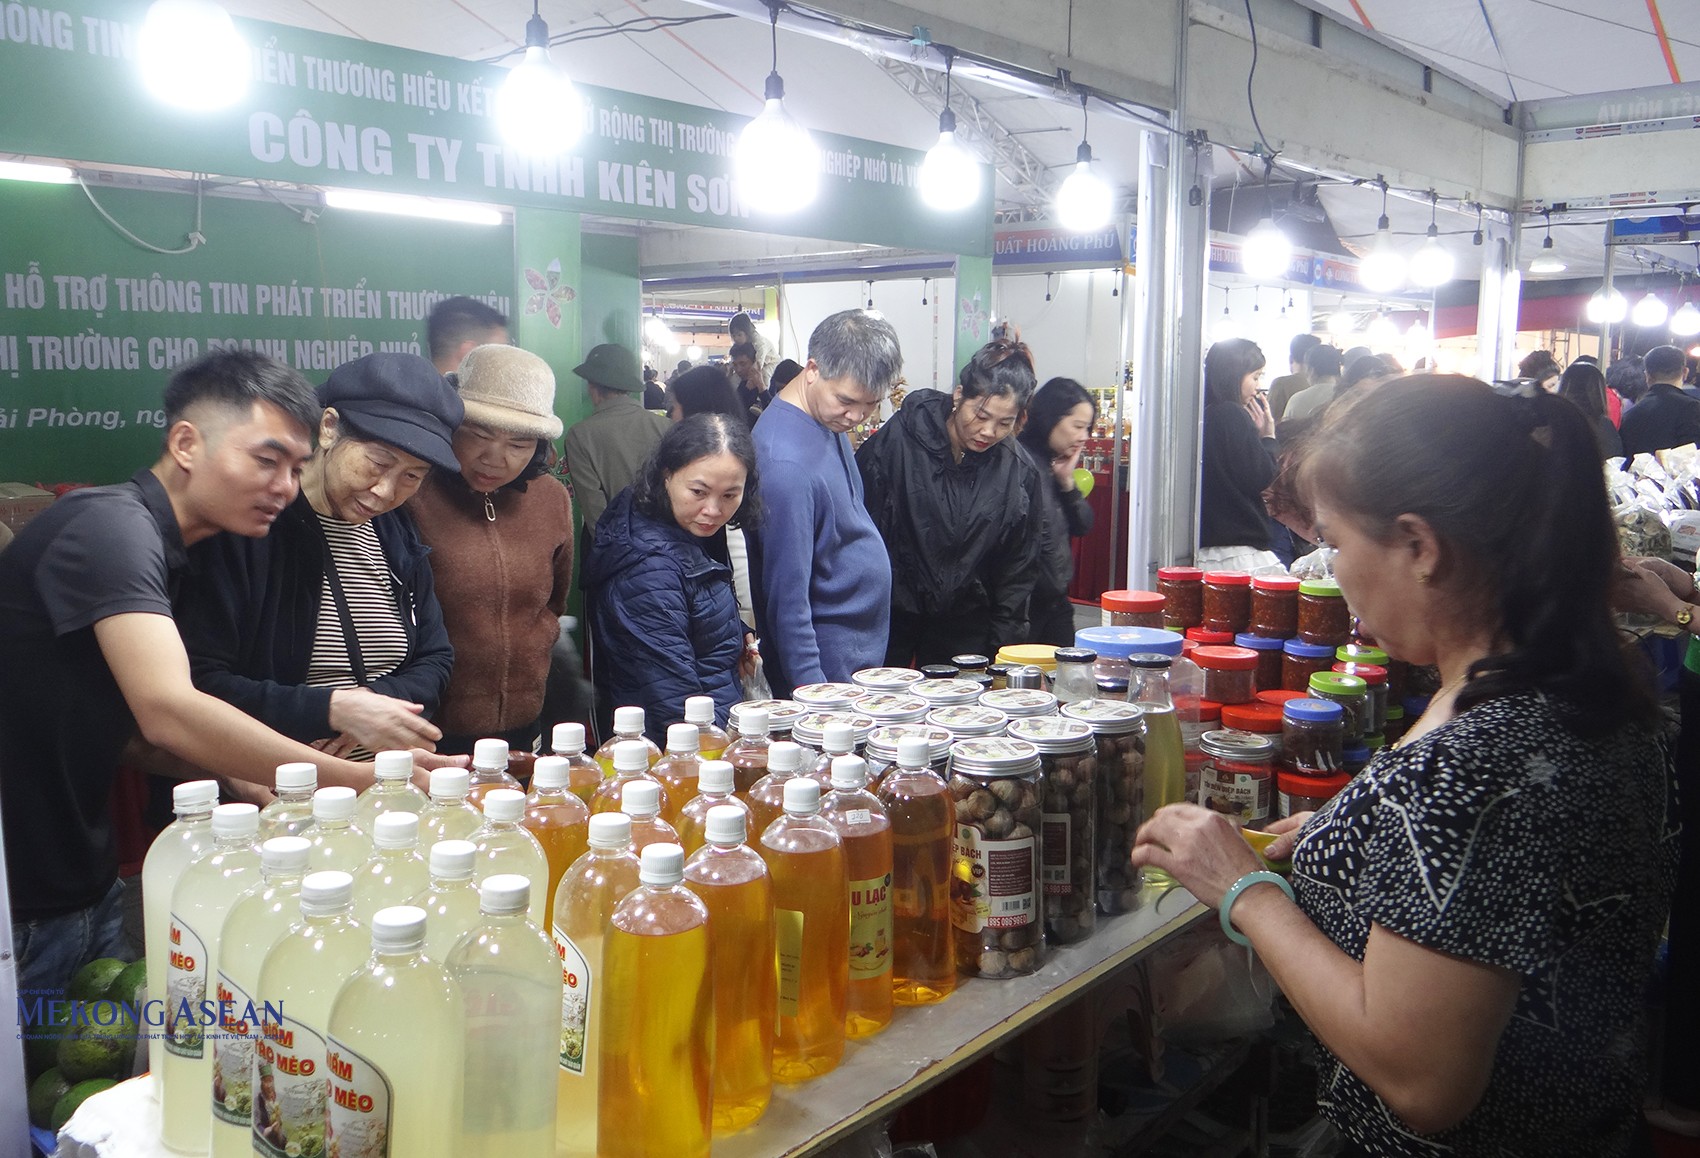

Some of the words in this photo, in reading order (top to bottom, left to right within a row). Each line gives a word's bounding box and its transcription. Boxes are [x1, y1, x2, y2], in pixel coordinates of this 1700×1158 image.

[249, 36, 297, 87] IỂN
[303, 55, 397, 103] THƯƠNG
[403, 70, 451, 115] HIỆU
[599, 105, 646, 146] RỘNG
[649, 117, 674, 154] THỊ
[864, 152, 888, 184] NHỎ
[889, 158, 905, 187] VÀ
[249, 107, 394, 177] CÔNG
[408, 133, 463, 183] TY
[476, 141, 586, 199] TNHH
[598, 159, 677, 210] KIÊN
[996, 235, 1023, 255] UẤT
[5, 261, 46, 310] HỖ
[53, 273, 108, 319] TRỢ
[115, 272, 203, 314] THÔNG
[209, 281, 249, 315] TIN
[256, 279, 314, 318] PHÁT
[320, 277, 382, 320] TRIỂN
[26, 327, 140, 371] TRƯỜNG
[148, 336, 199, 370] CHO
[27, 406, 126, 430] Phòng,
[136, 409, 168, 429] ng
[960, 844, 982, 860] BÁCH
[866, 884, 887, 906] LẠC
[563, 966, 578, 989] ÈO
[276, 1052, 316, 1077] MÈO
[334, 1086, 375, 1113] MÈO
